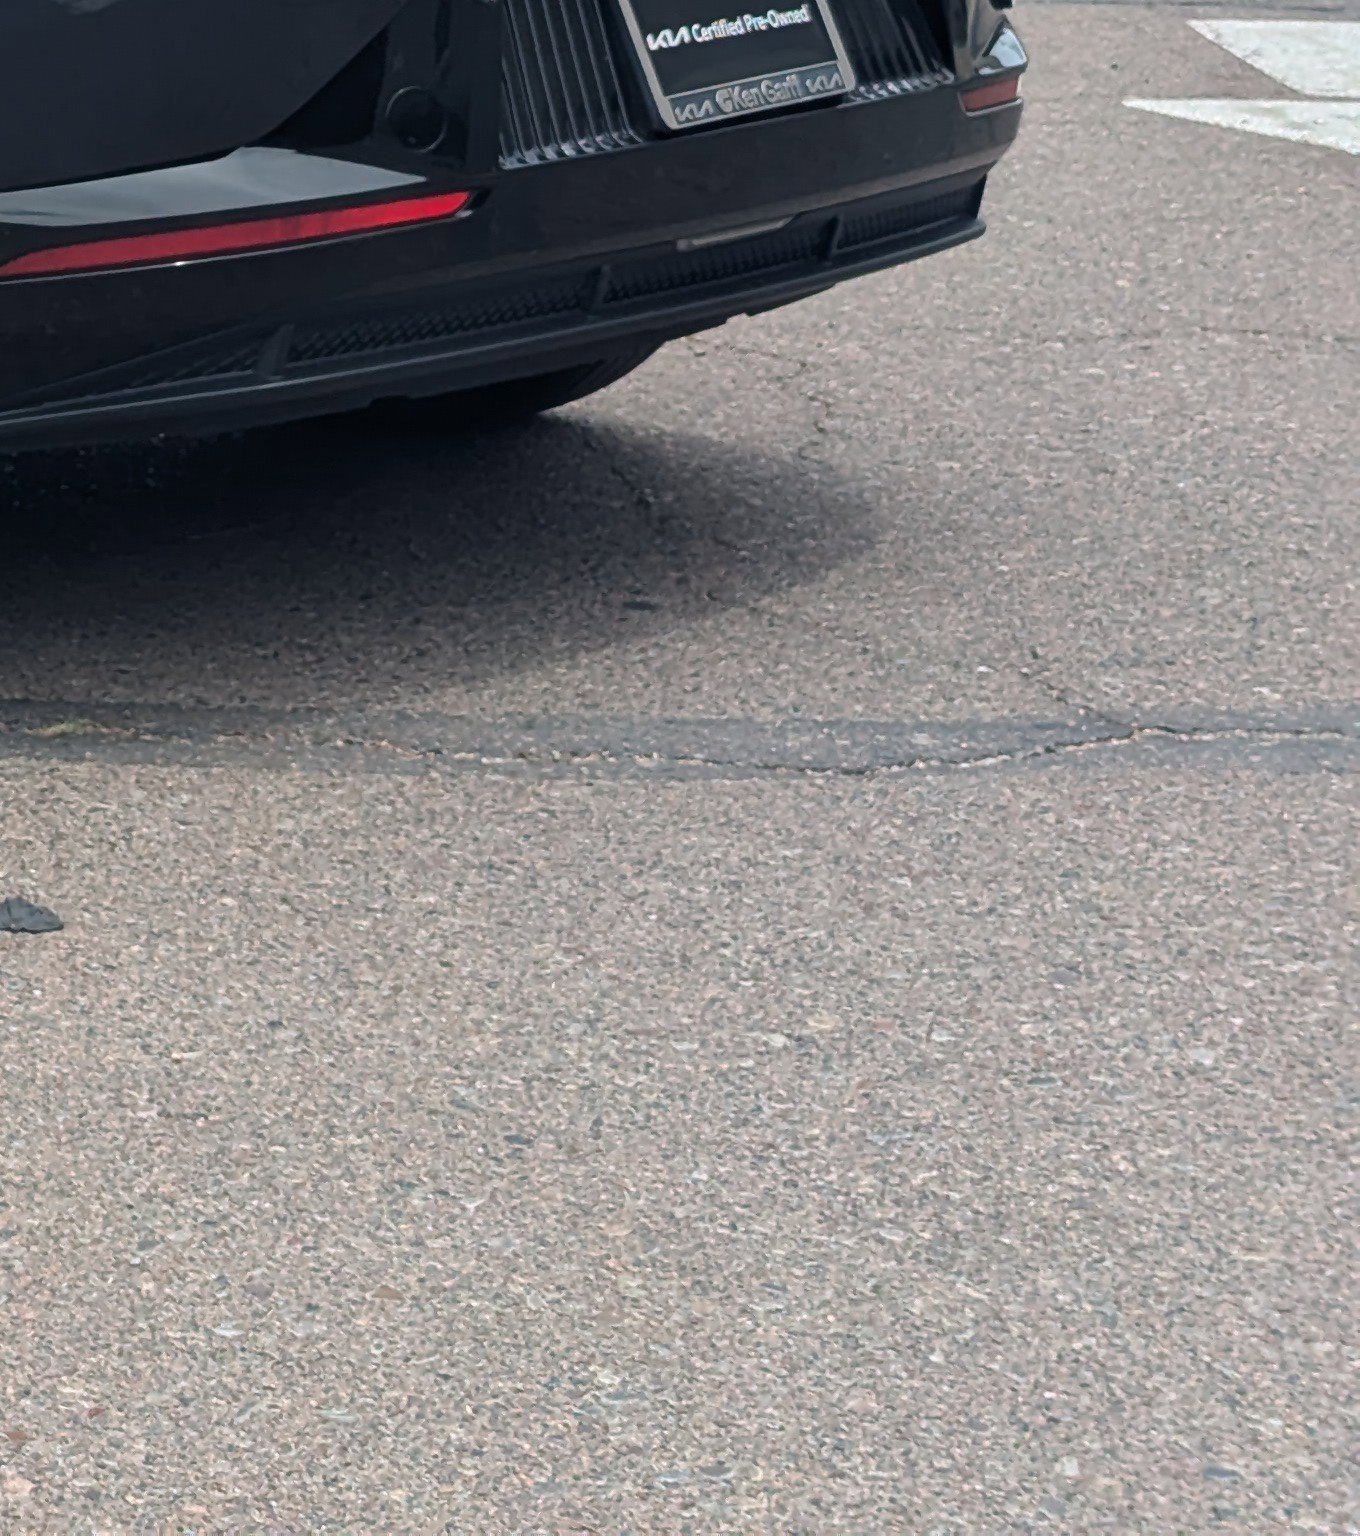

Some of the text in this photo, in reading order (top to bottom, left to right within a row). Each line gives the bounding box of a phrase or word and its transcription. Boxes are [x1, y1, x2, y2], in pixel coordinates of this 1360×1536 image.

[646, 25, 691, 51] KIA
[691, 19, 744, 44] Certified
[674, 72, 843, 122] KIA Ken Garff KIA
